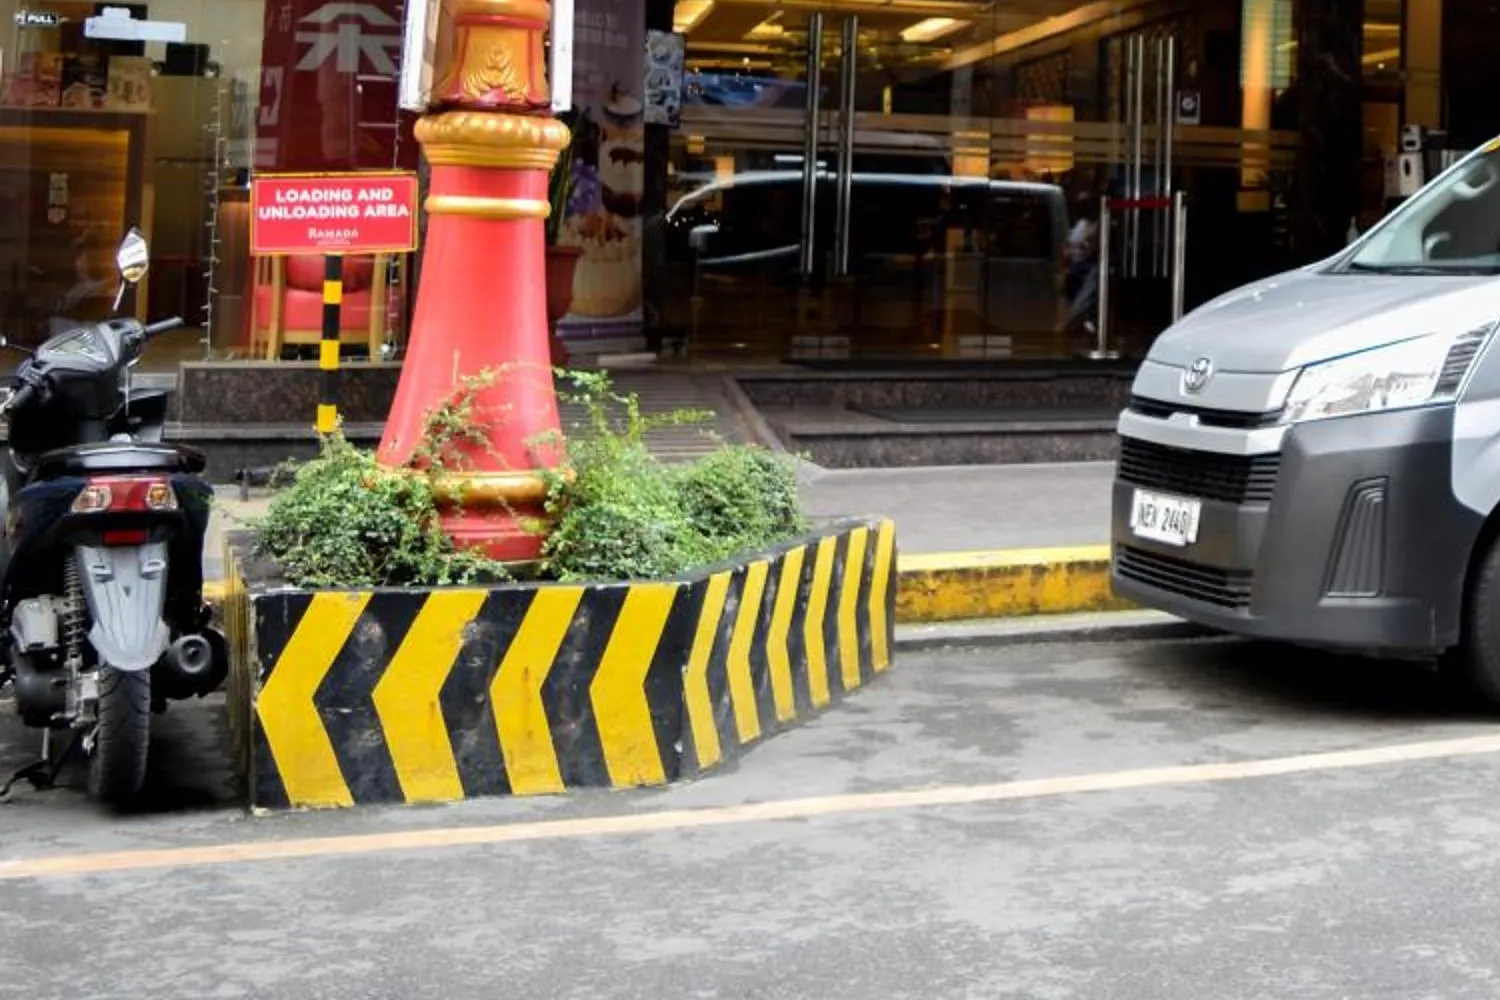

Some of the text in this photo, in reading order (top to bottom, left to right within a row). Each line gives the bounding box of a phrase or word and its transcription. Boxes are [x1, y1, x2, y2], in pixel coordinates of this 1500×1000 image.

[27, 13, 53, 24] PULL
[275, 187, 394, 203] LOADING AND
[259, 203, 409, 220] UNLOADING AREA
[308, 227, 359, 240] RAMADA
